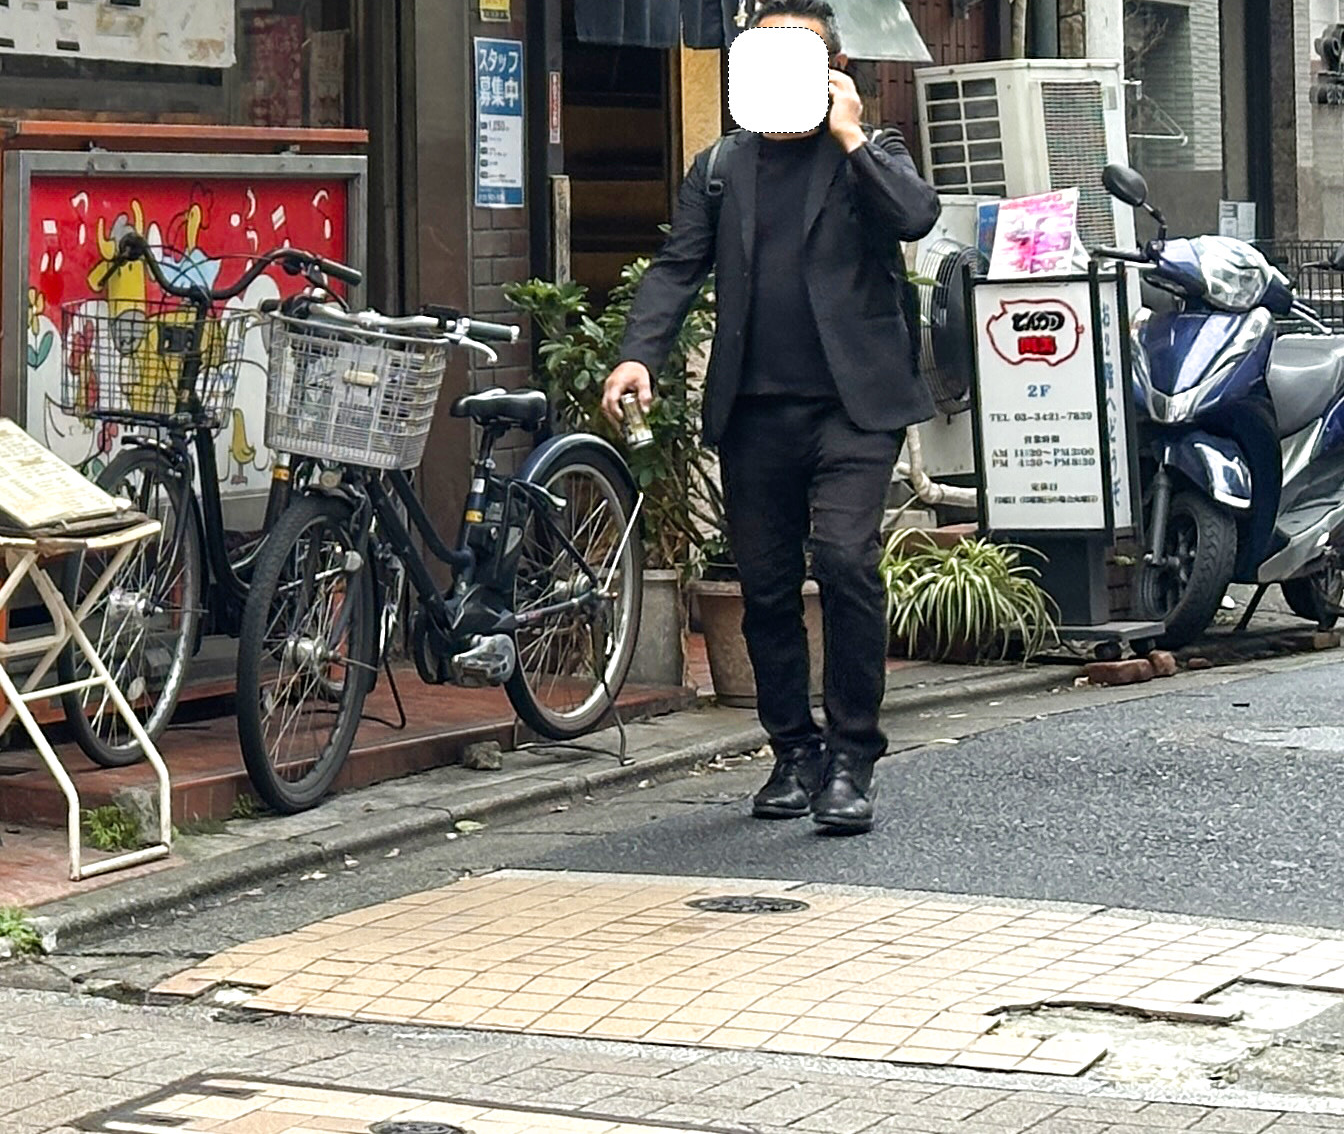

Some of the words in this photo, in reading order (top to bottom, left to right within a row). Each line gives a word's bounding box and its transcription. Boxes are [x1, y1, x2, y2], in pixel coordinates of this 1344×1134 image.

[479, 47, 519, 72] スタッフ
[479, 76, 519, 108] 募集中
[1027, 384, 1052, 398] 2F
[990, 413, 1010, 422] TEL
[992, 449, 1008, 458] AM
[992, 459, 1008, 468] PM
